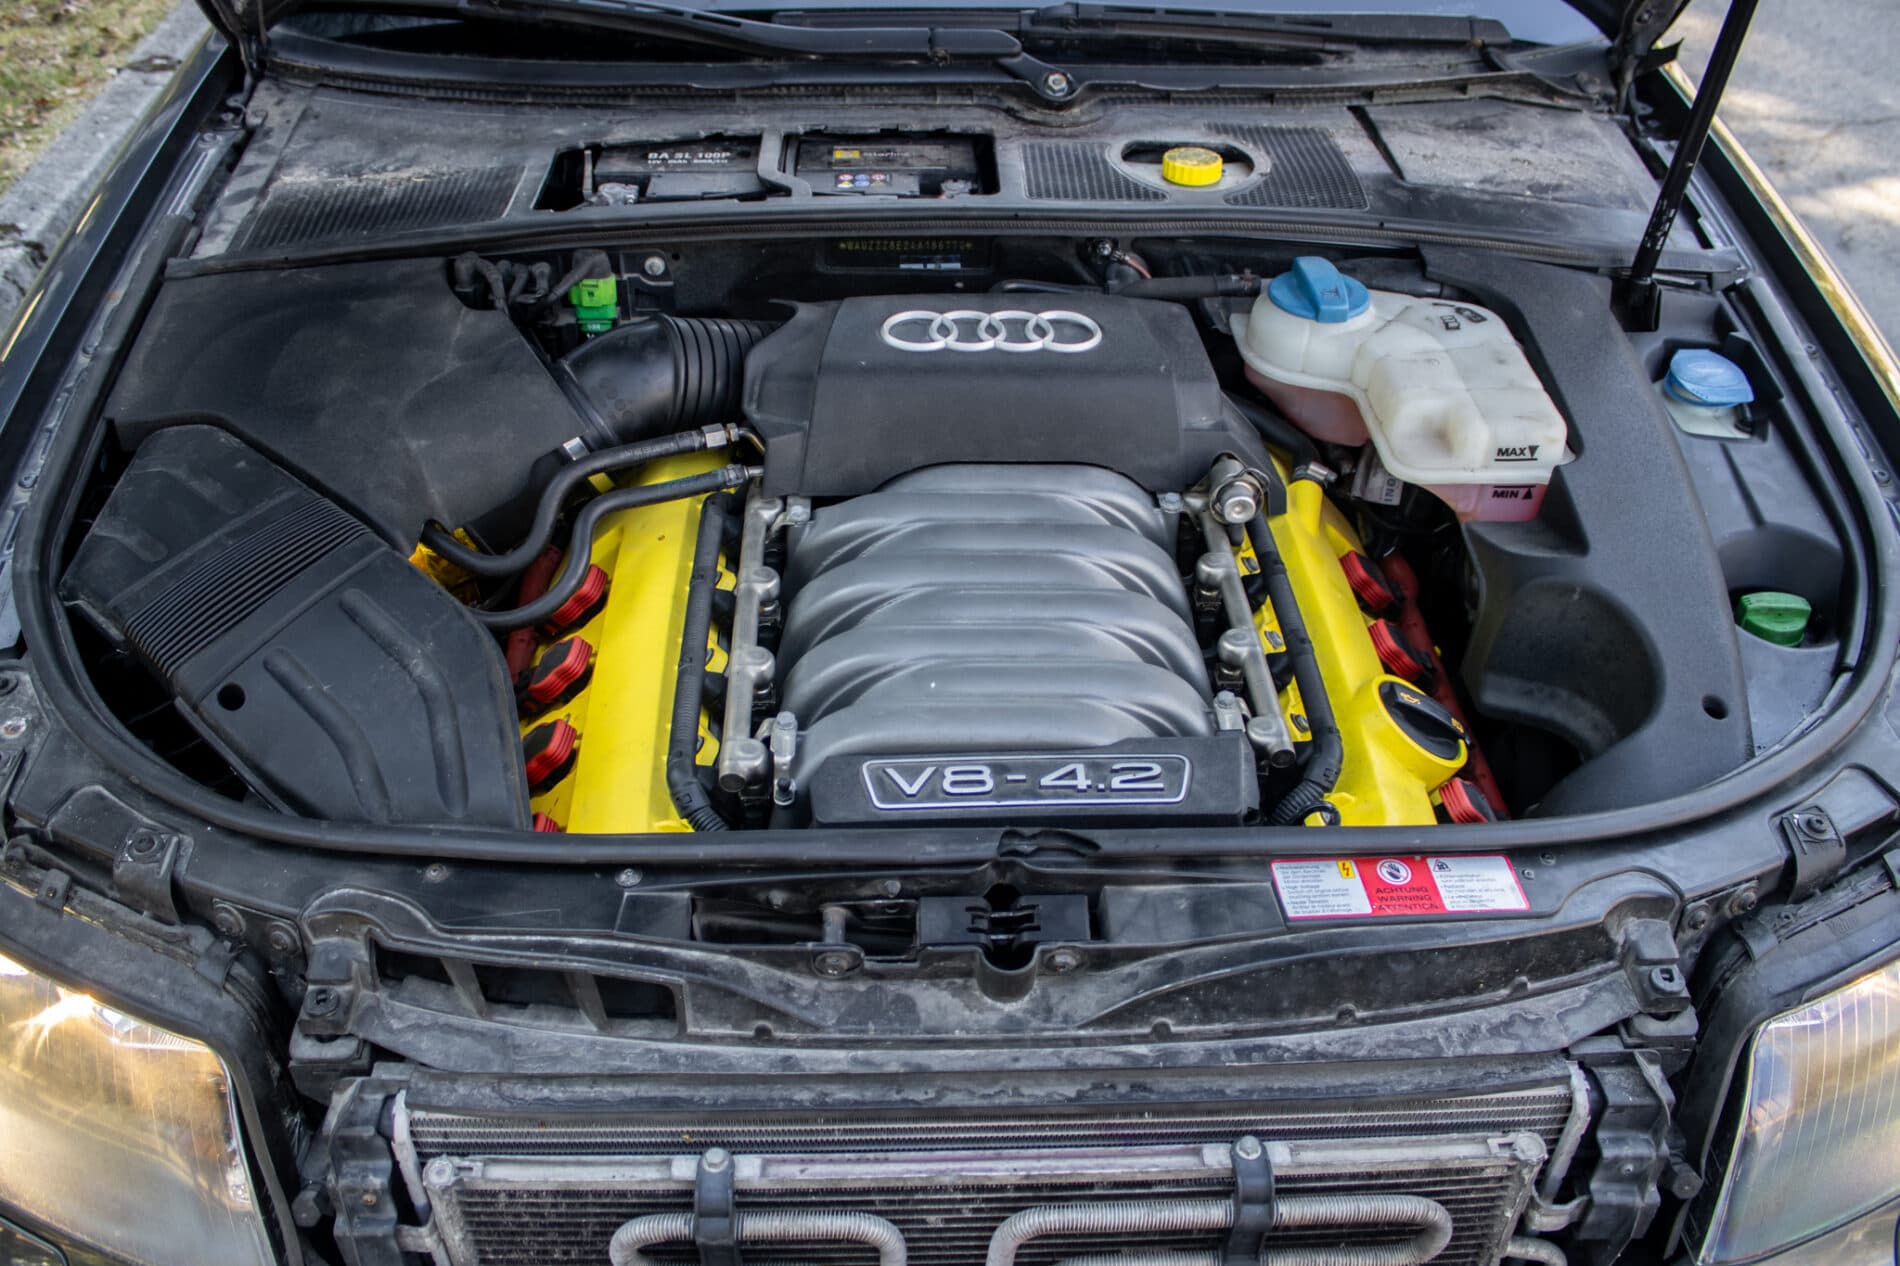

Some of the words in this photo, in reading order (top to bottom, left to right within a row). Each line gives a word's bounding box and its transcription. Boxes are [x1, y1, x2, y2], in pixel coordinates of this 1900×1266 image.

[1497, 447, 1526, 456] MAX
[1492, 490, 1519, 498] MIN
[1376, 886, 1429, 894] ACHTUNG
[1379, 903, 1438, 911] ATTENTION
